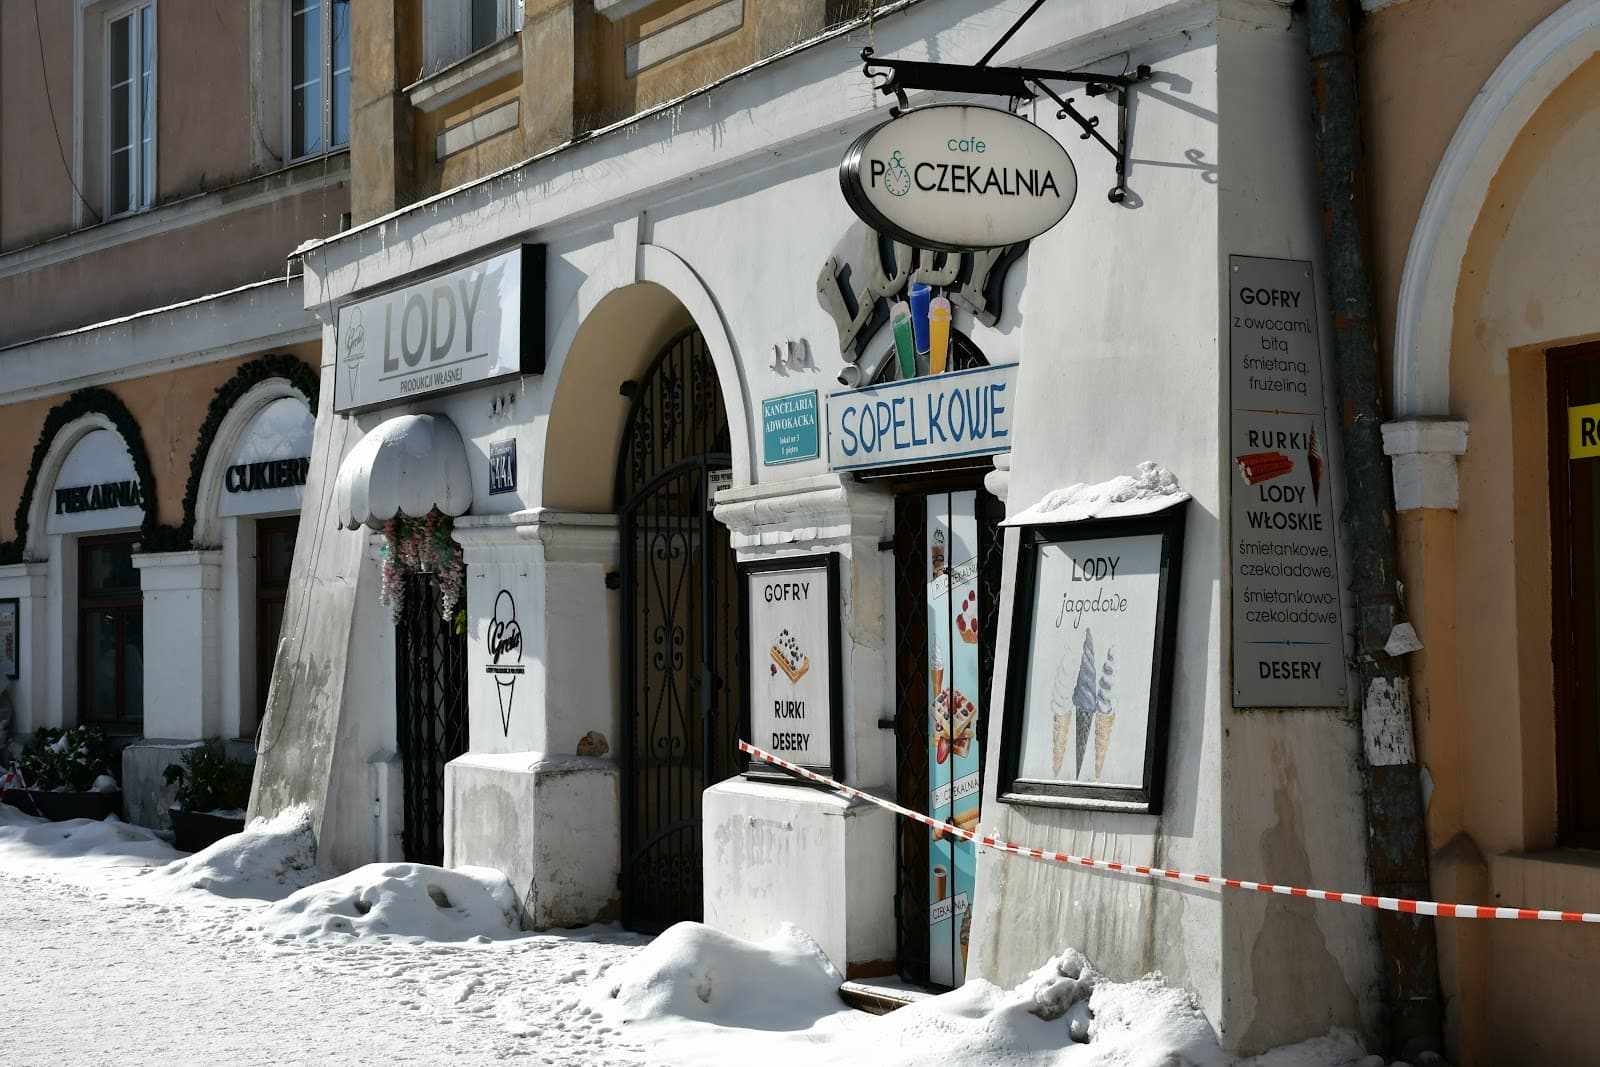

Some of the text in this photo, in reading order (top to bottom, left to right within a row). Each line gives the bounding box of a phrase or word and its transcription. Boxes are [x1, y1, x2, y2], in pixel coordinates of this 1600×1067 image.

[948, 136, 986, 153] cafe
[1240, 287, 1300, 308] GOFRY
[383, 267, 487, 373] LODY
[1234, 316, 1312, 334] z owocami,
[1261, 336, 1288, 354] bitą
[1243, 354, 1310, 376] śmietaną,
[400, 367, 463, 393] PRODUKCJI WŁASNEJ
[1249, 376, 1307, 396] frużeliną
[765, 398, 813, 417] KANCELARIA
[765, 414, 814, 432] ADWOKACKA
[841, 382, 1009, 456] SOPELKOWE
[1248, 430, 1308, 450] RURKI
[55, 480, 141, 514] PIEKARNIA
[1260, 485, 1306, 504] LODY
[1247, 511, 1323, 531] WŁOSKIE
[1239, 538, 1332, 558] śmietankowe,
[1072, 556, 1120, 581] LODY
[1240, 562, 1335, 579] czekoladowe,
[765, 582, 810, 602] GOFRY
[1243, 586, 1336, 605] śmietankowo-
[1056, 588, 1128, 629] jagodowe
[1246, 609, 1337, 624] czekoladowe
[1259, 661, 1321, 680] DESERY
[774, 700, 805, 719] RURKI
[772, 732, 810, 751] DESERY
